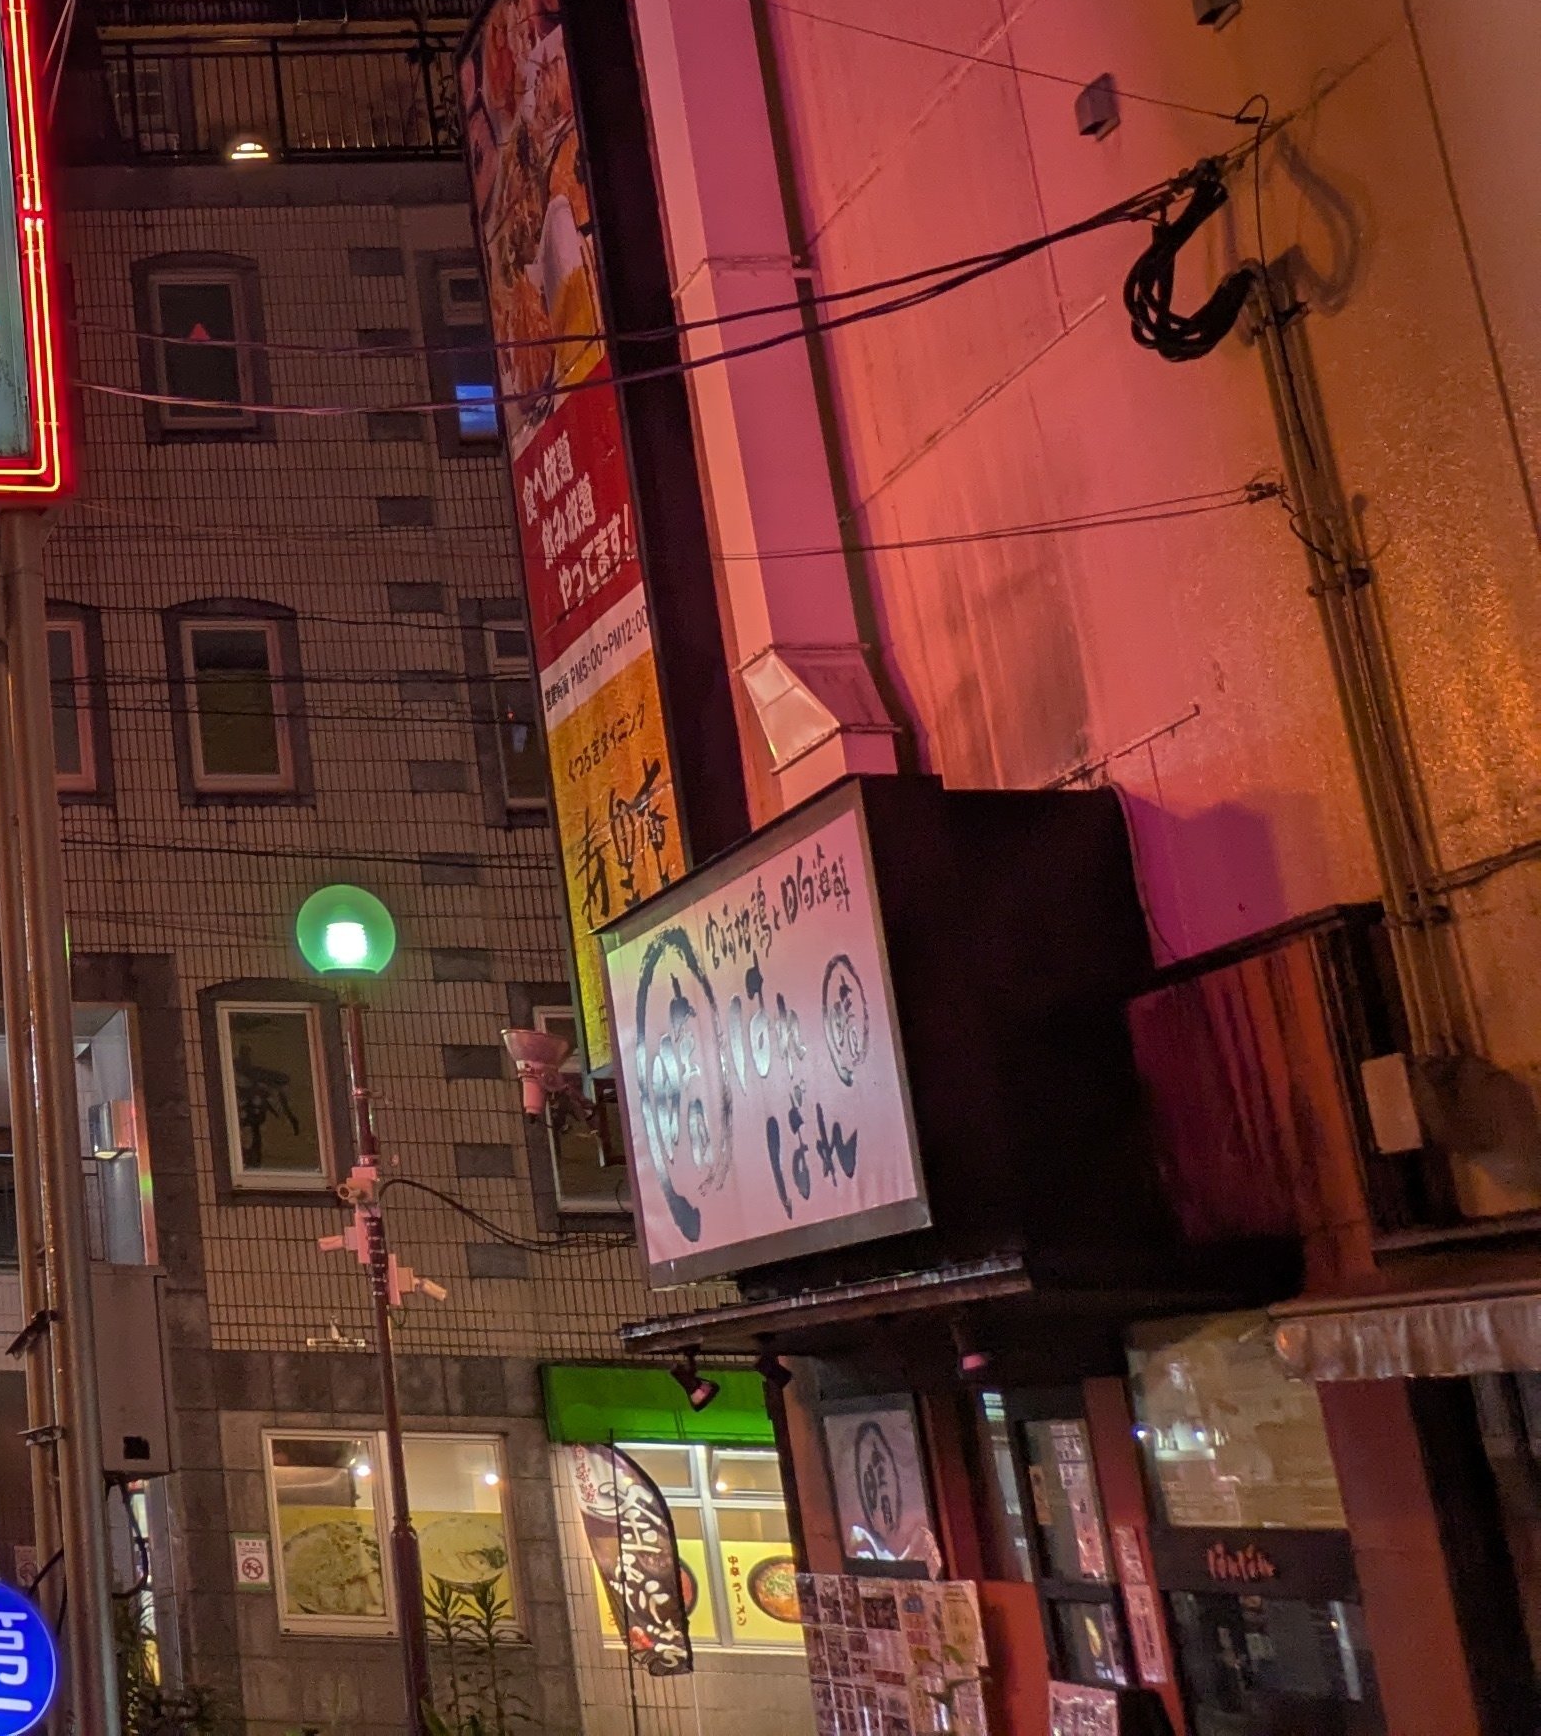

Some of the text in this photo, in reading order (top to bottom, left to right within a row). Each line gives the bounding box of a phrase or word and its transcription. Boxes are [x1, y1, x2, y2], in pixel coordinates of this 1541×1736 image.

[522, 429, 574, 526] 食べ放題
[541, 471, 597, 569] 飲み放題
[732, 1582, 748, 1627] ラーメン
